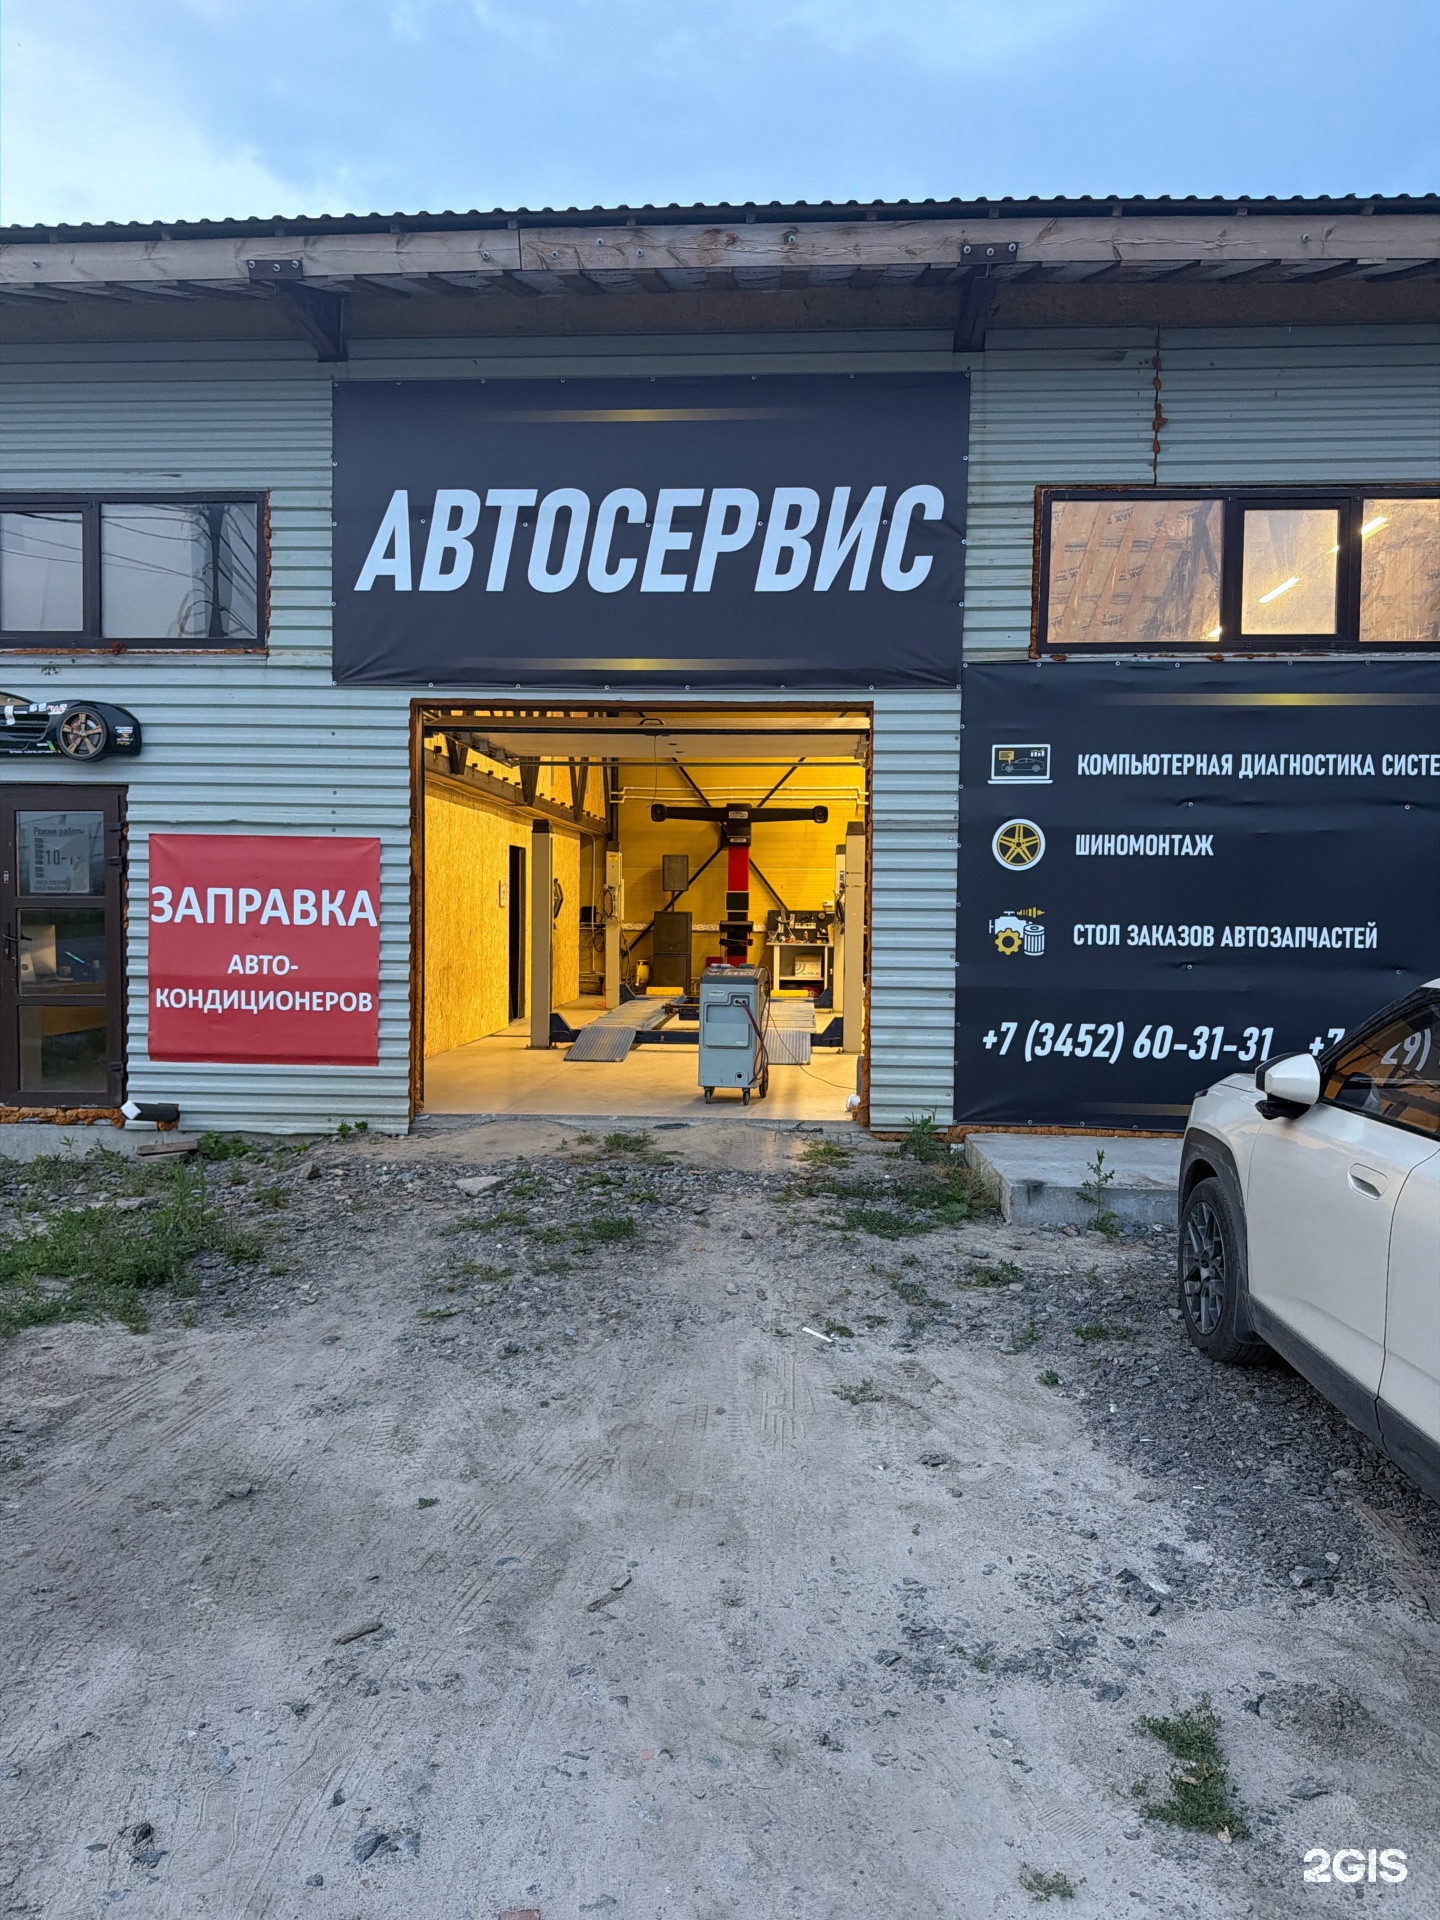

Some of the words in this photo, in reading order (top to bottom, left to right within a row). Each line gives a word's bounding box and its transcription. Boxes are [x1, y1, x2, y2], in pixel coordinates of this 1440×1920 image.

[354, 484, 945, 593] АВТОСЕРВИС
[1077, 753, 1233, 776] КОМПЬЮТЕРНАЯ
[1238, 753, 1376, 779] ДИАГНОСТИКА
[1381, 753, 1440, 776] СИСТЕ
[1075, 834, 1214, 856] ШИНОМОНТАЖ
[150, 885, 378, 927] ЗАПРАВКА
[1073, 923, 1120, 946] СТОЛ
[1126, 924, 1215, 947] ЗАКАЗОВ
[1220, 921, 1378, 949] АВТОЗАПЧАСТЕЙ
[227, 954, 299, 976] АВТО-
[155, 987, 373, 1015] КОНДИЦИОНЕРОВ
[982, 1021, 1018, 1056] +7
[1024, 1019, 1125, 1065] (3452)
[1132, 1024, 1274, 1062] 60-31-31
